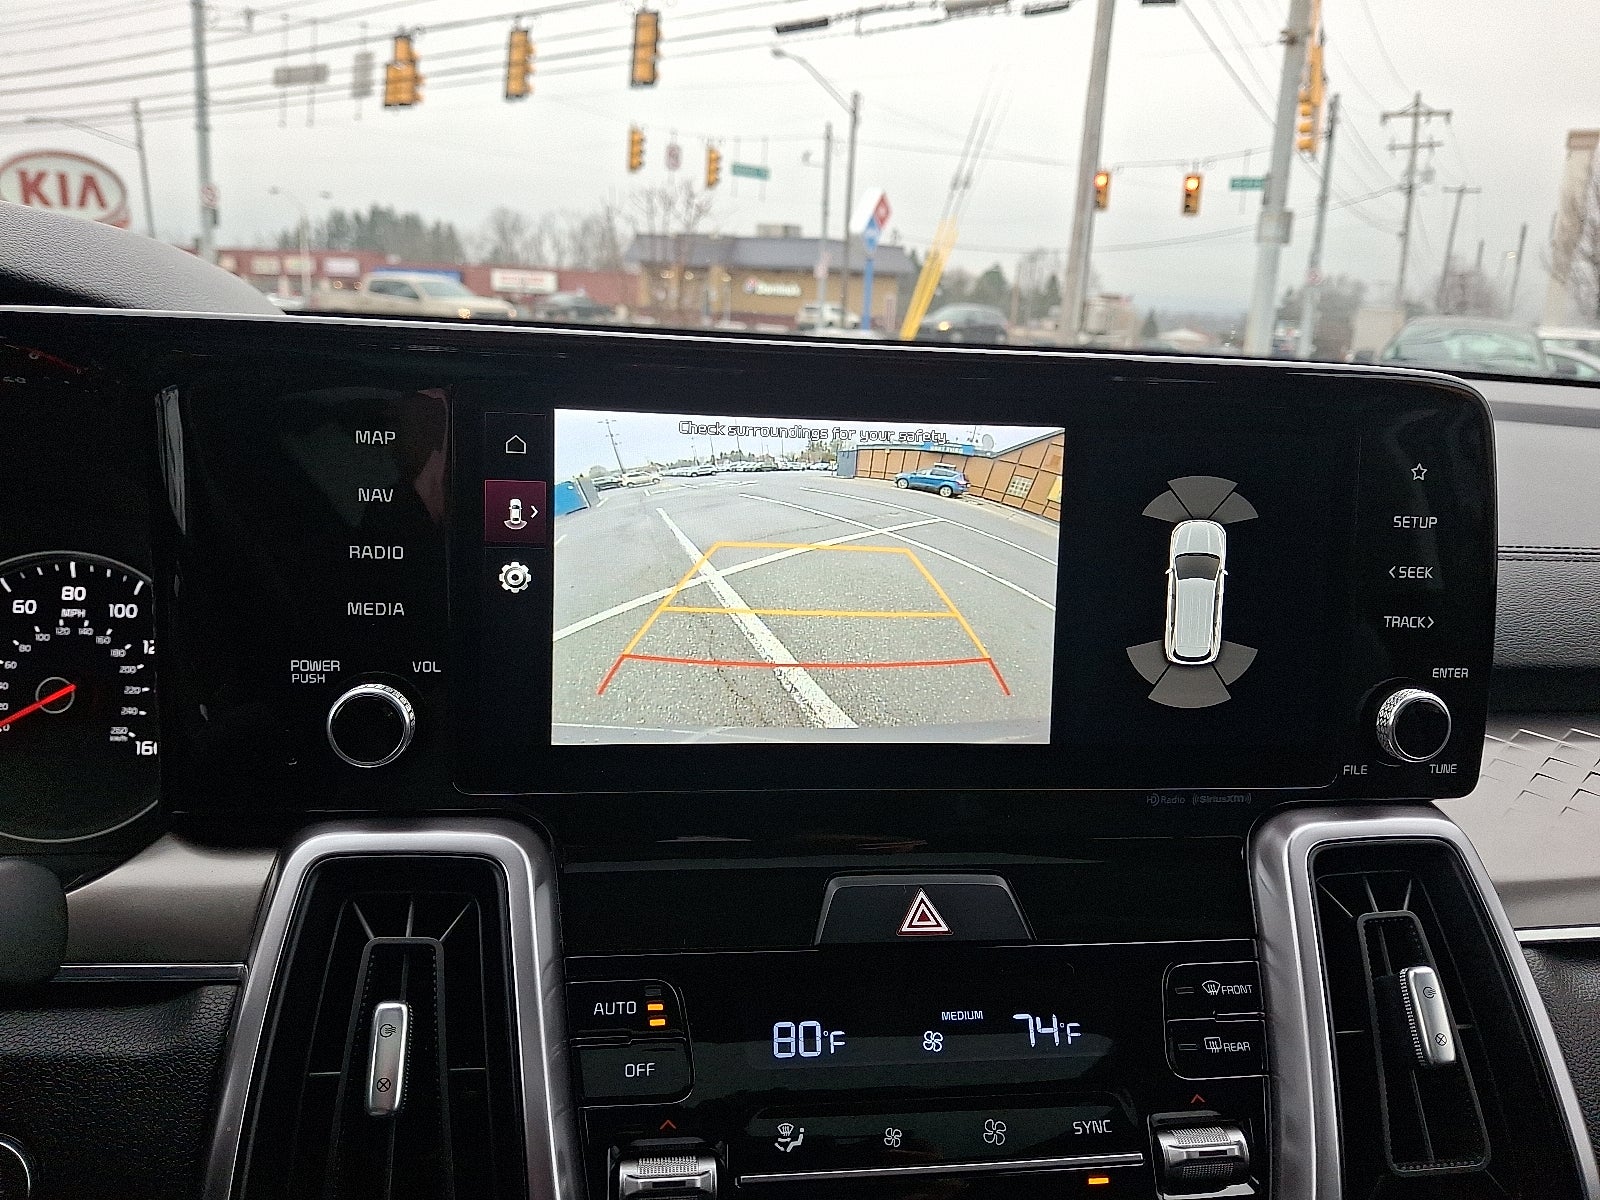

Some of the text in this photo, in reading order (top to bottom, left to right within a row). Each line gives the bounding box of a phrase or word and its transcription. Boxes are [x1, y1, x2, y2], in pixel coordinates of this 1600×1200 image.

[18, 169, 107, 209] KIA
[355, 430, 396, 445] MAP
[679, 421, 725, 435] Check
[727, 425, 829, 441] surroundings
[832, 427, 856, 440] for
[860, 430, 895, 442] your
[358, 488, 394, 502] NAV
[1393, 515, 1438, 529] SETUP
[349, 545, 404, 560] RADIO
[1398, 566, 1433, 579] SEEK
[61, 586, 87, 601] 80
[12, 599, 37, 614] 60
[61, 608, 86, 618] MPH
[108, 603, 138, 619] 100
[347, 602, 405, 616] MEDIA
[1384, 616, 1425, 629] TRACK
[35, 633, 51, 642] 100
[18, 644, 32, 653] 80
[4, 660, 18, 670] 60
[290, 660, 341, 672] POWER
[412, 661, 441, 673] VOL
[291, 673, 326, 684] PUSH
[1432, 667, 1468, 678] ENTER
[1343, 764, 1368, 775] FILE
[1429, 763, 1457, 774] TUNE
[1160, 795, 1186, 804] Radio
[1221, 984, 1252, 996] FRONT
[593, 1000, 637, 1016] AUTO
[941, 1010, 984, 1022] MEDIUM
[1223, 1041, 1251, 1053] REAR
[624, 1062, 656, 1078] OFF
[1072, 1119, 1112, 1135] SYNC
